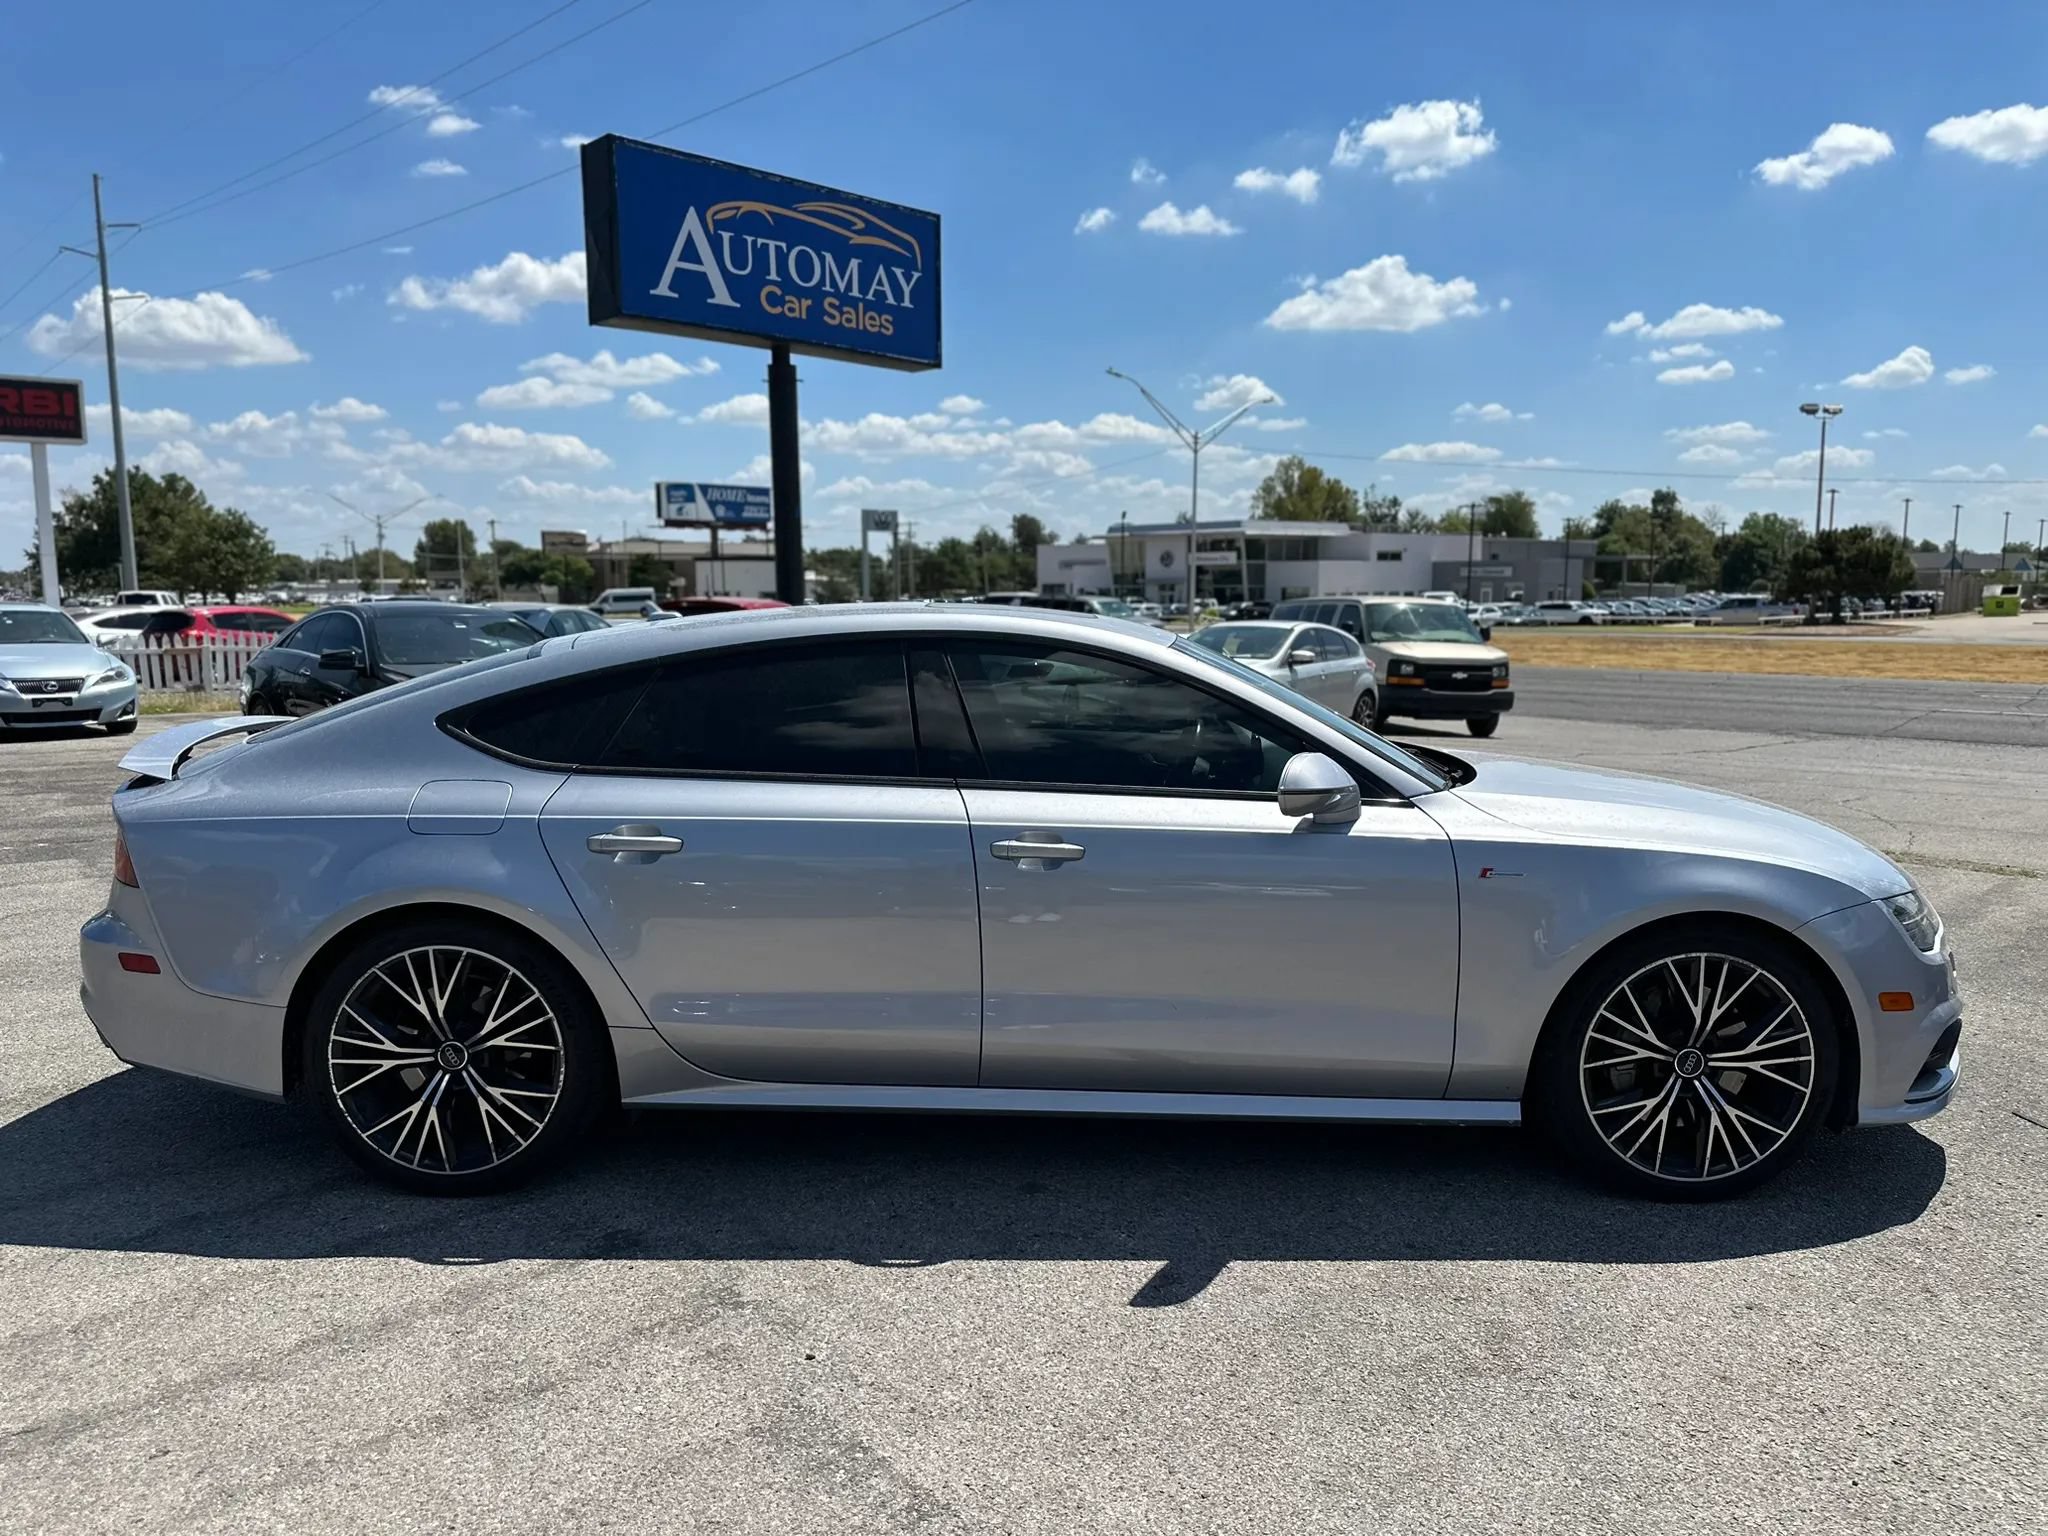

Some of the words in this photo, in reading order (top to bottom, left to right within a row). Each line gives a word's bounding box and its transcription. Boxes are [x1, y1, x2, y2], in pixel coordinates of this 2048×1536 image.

[650, 206, 922, 309] AUTOMAY
[760, 285, 812, 320] Car
[823, 297, 894, 336] Sales
